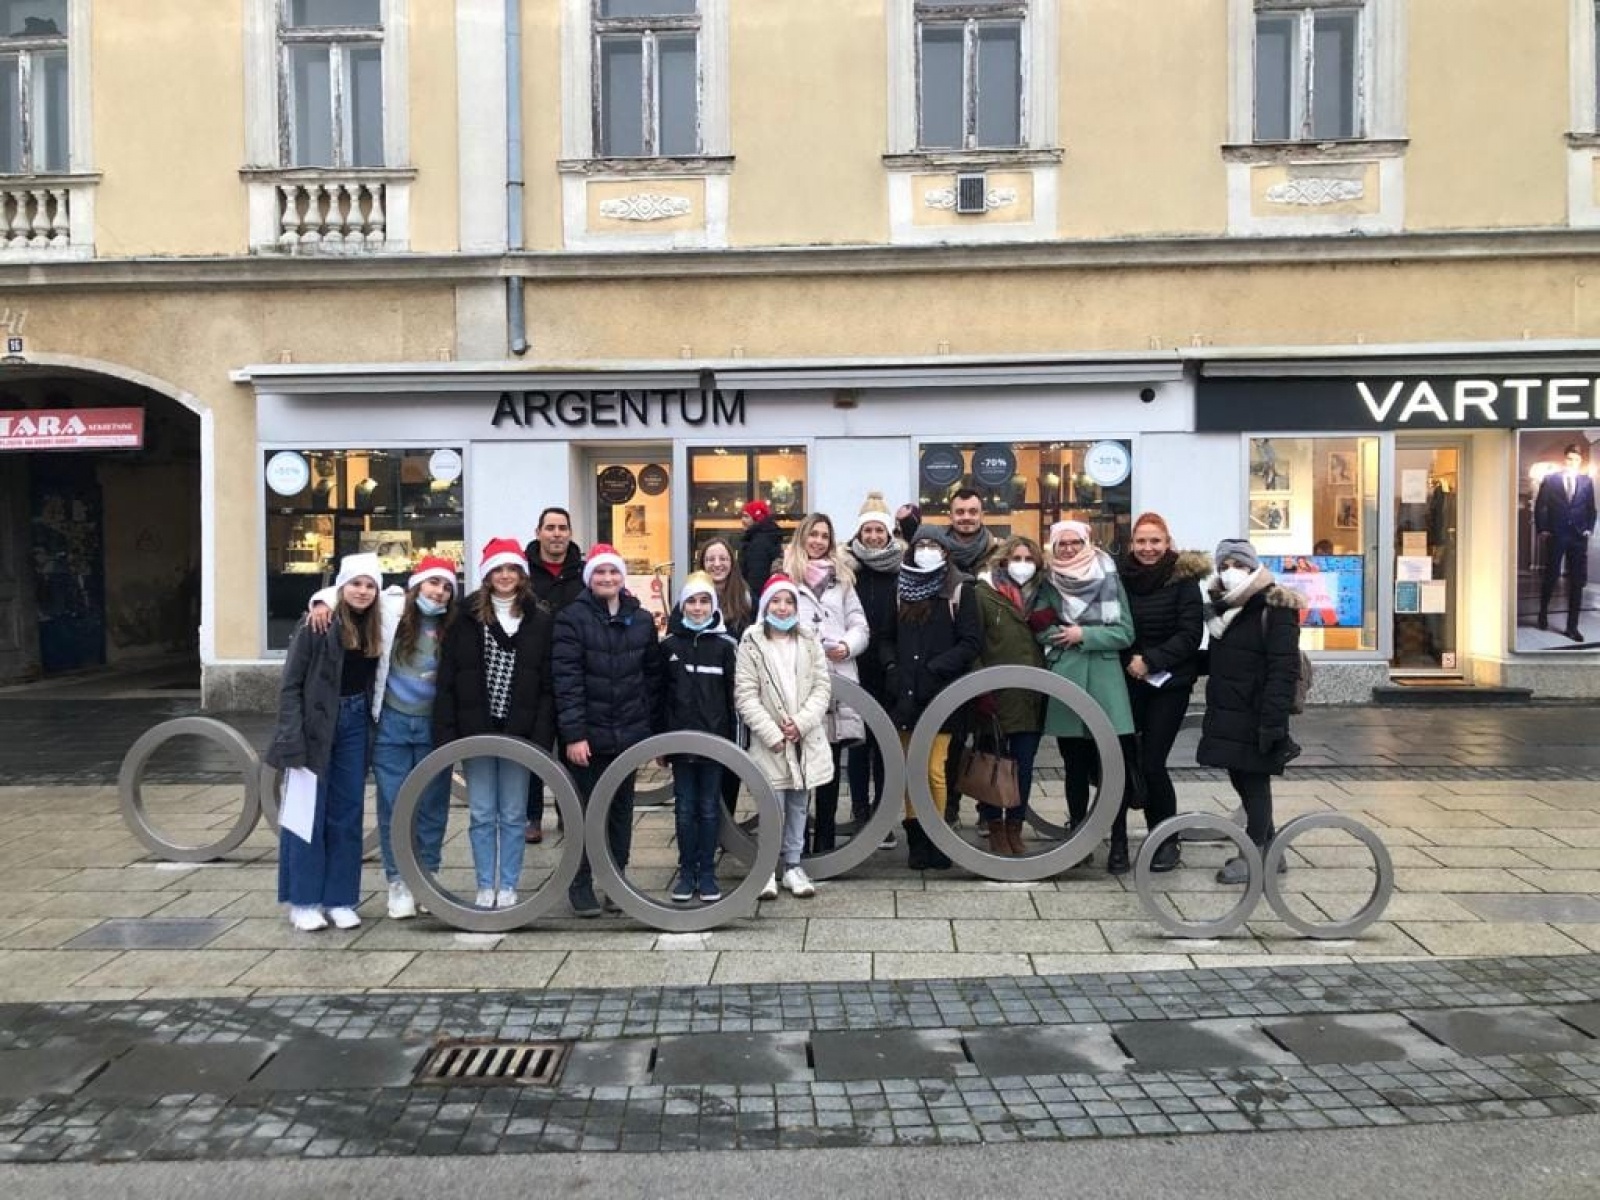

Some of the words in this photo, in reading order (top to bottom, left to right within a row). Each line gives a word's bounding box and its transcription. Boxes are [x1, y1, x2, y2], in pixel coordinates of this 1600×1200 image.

[491, 388, 746, 427] ARGENTUM
[1357, 379, 1600, 422] VARTE
[980, 458, 1007, 467] -70%
